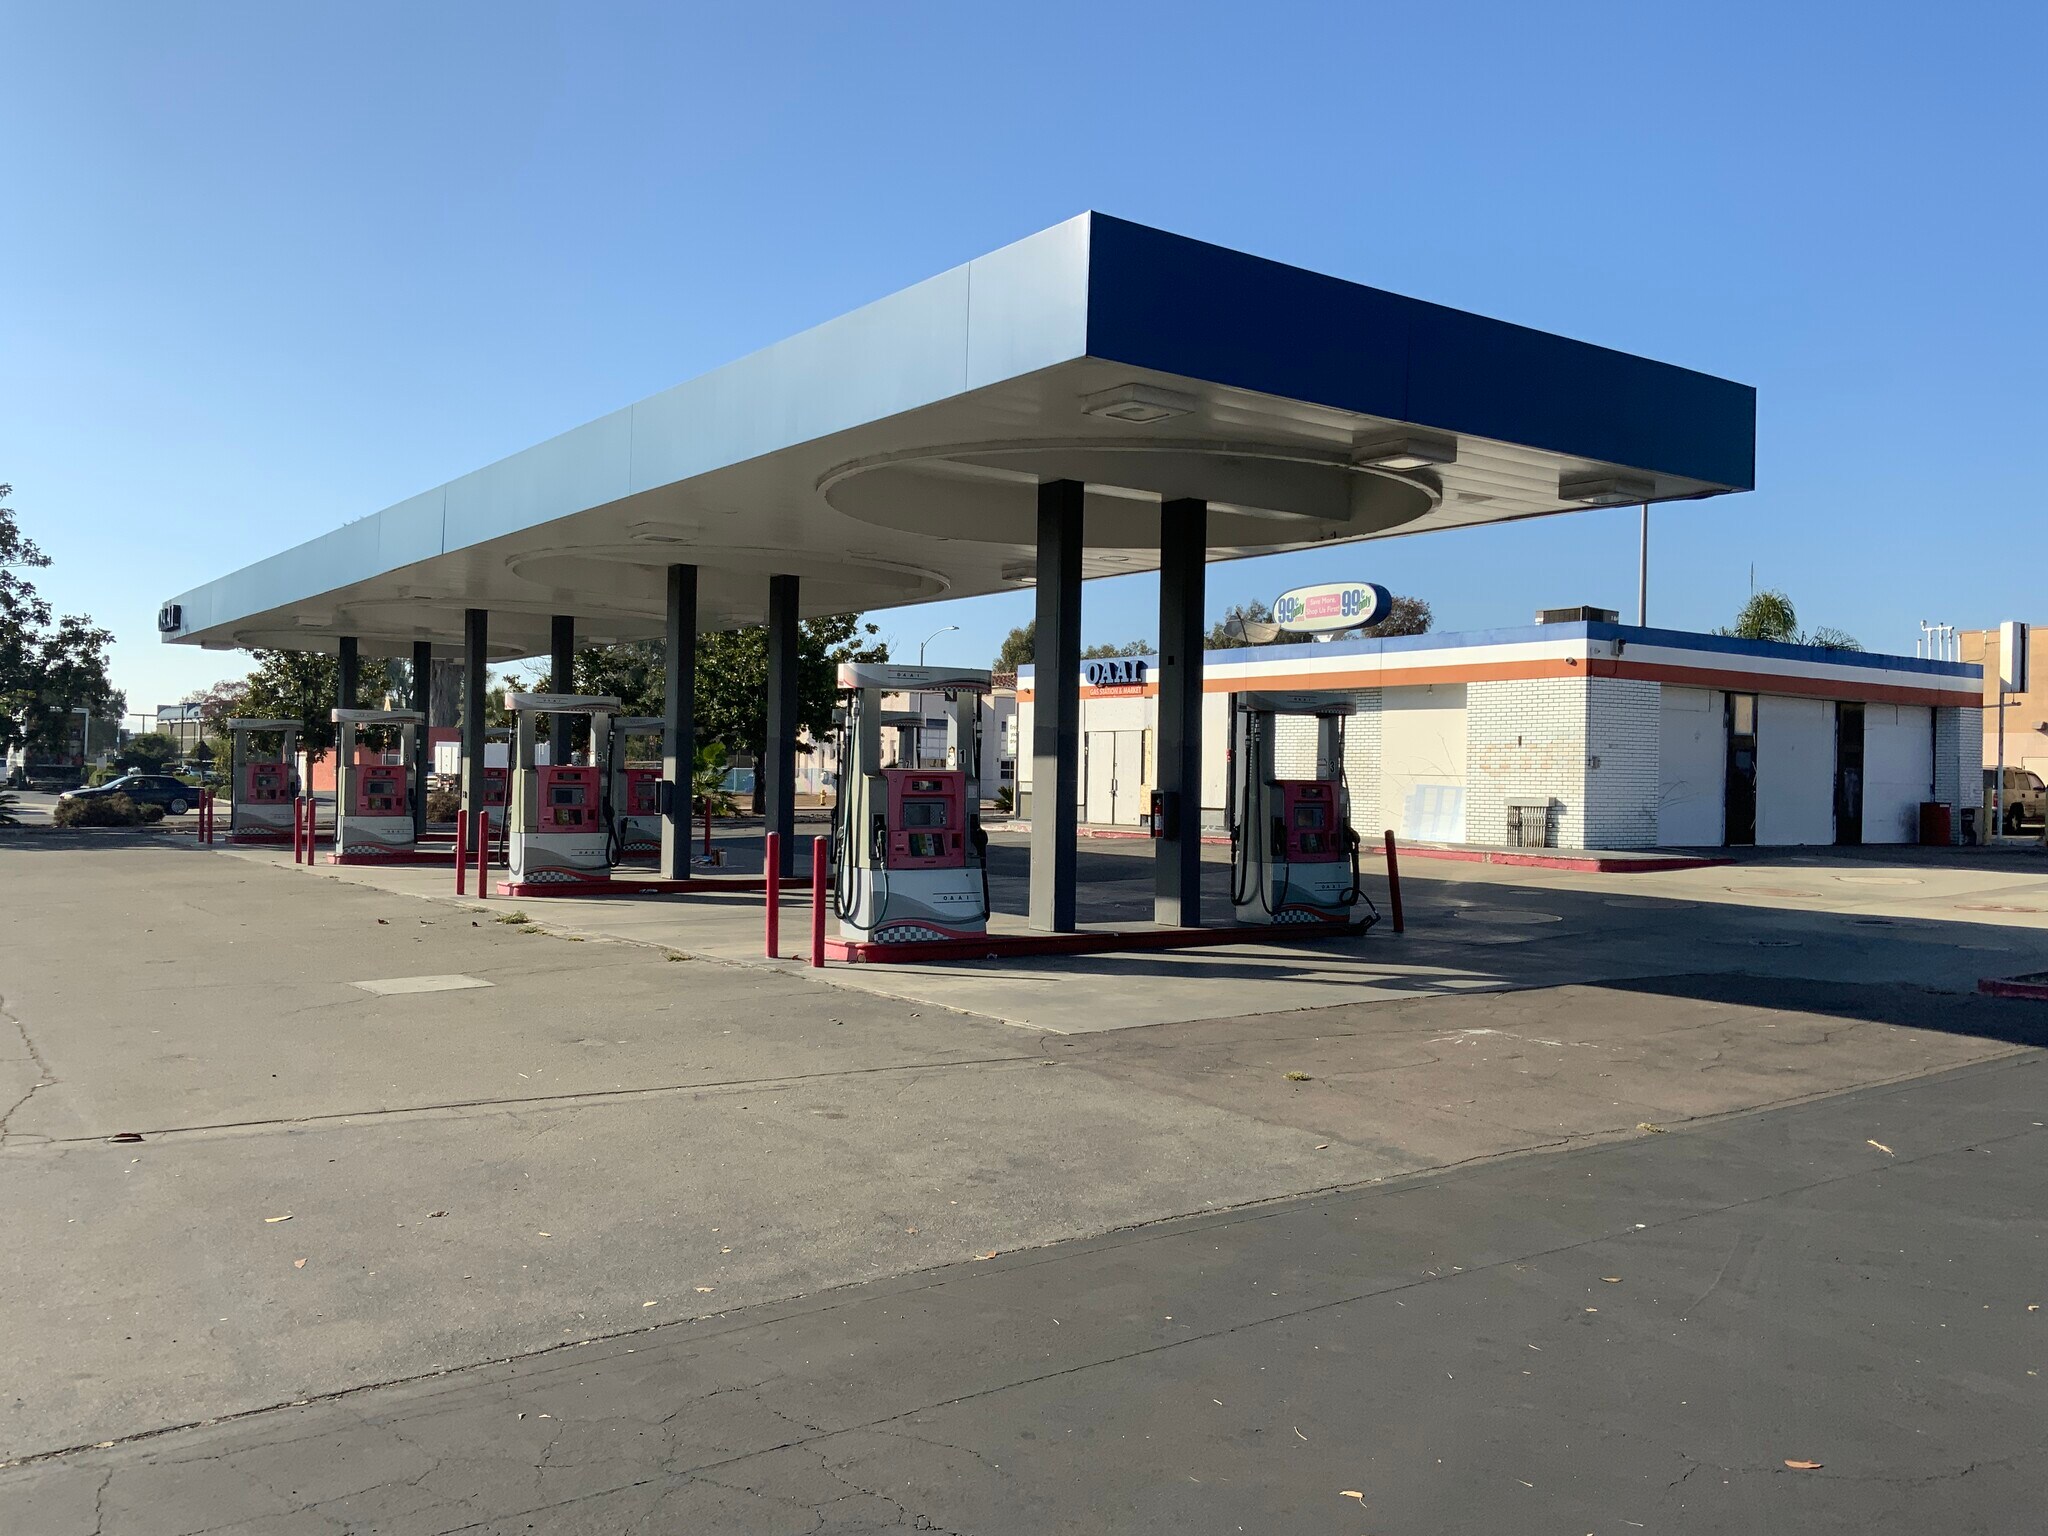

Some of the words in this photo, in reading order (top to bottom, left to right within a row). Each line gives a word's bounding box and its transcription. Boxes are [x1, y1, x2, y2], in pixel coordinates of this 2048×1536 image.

[1310, 598, 1320, 606] Save
[1306, 608, 1318, 616] Shop
[1089, 688, 1099, 696] GAS
[1099, 686, 1119, 695] STATION
[1123, 686, 1142, 694] MARKET
[959, 749, 966, 764] 1
